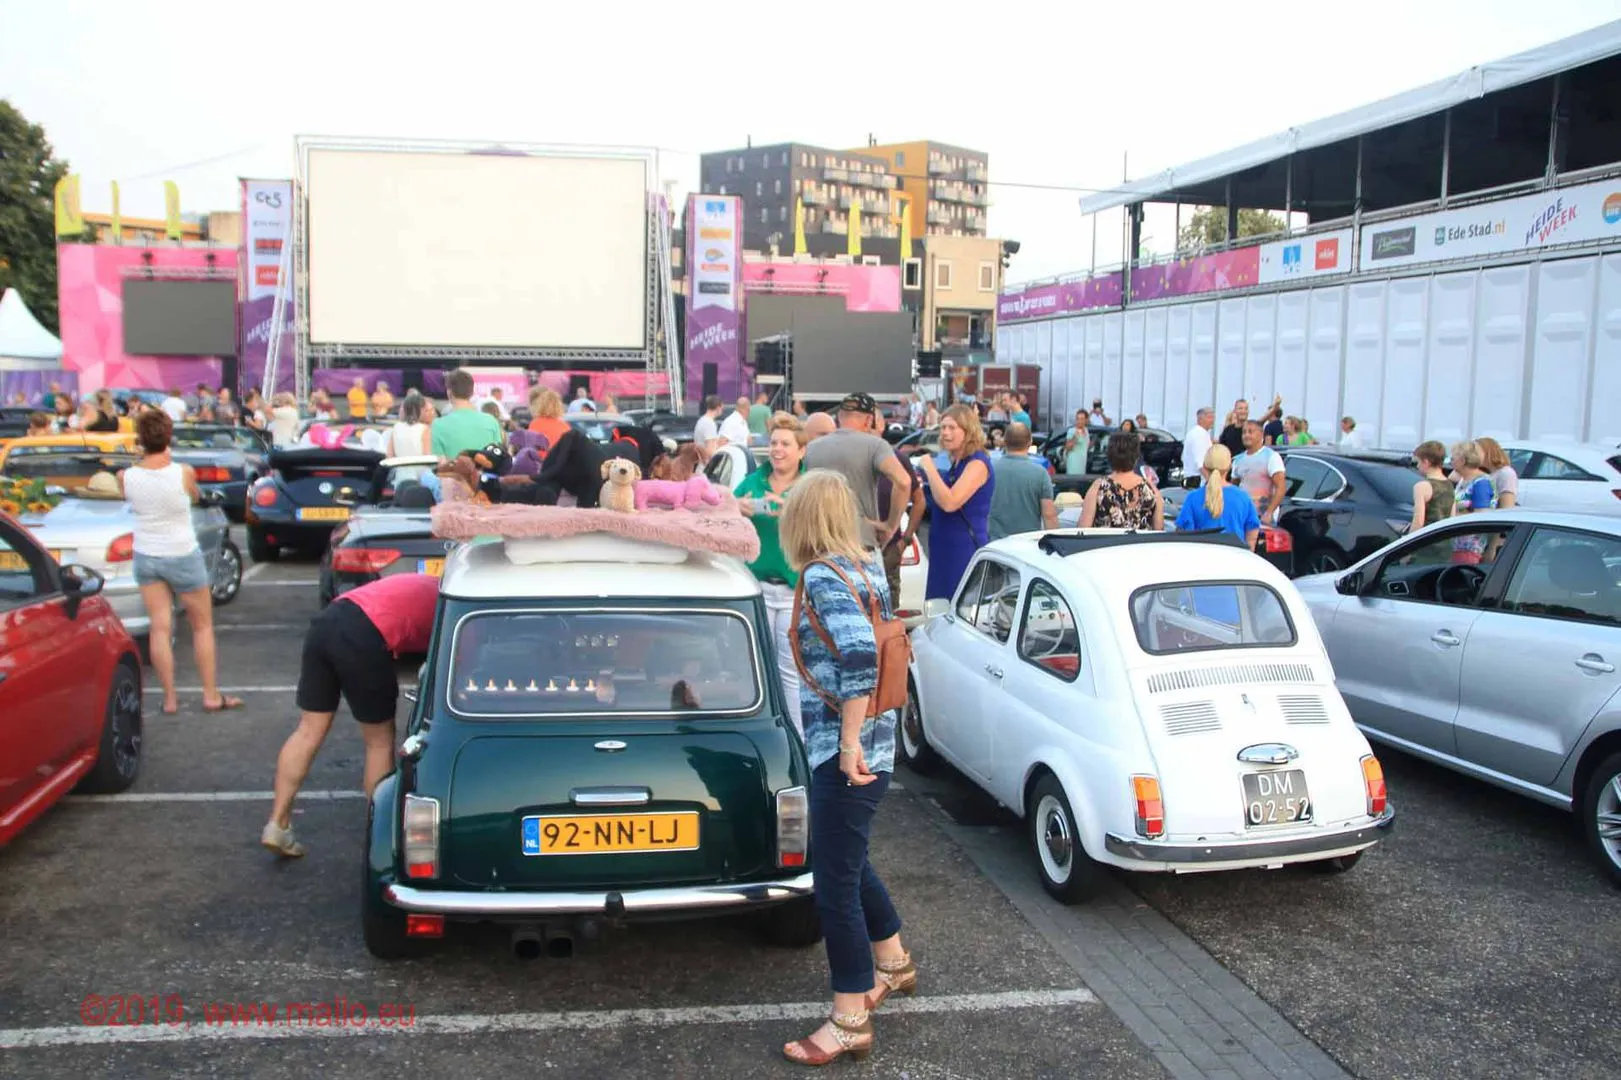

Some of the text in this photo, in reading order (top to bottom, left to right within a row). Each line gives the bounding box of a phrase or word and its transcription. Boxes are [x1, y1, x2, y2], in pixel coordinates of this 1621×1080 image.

[1448, 219, 1506, 241] Ede Stad.nl
[1525, 197, 1563, 246] HEIDE
[1539, 204, 1577, 243] WEEK
[690, 322, 723, 350] HEIDE
[1257, 772, 1293, 796] DM
[526, 839, 539, 848] NL
[543, 819, 679, 847] 92-NN-LJ
